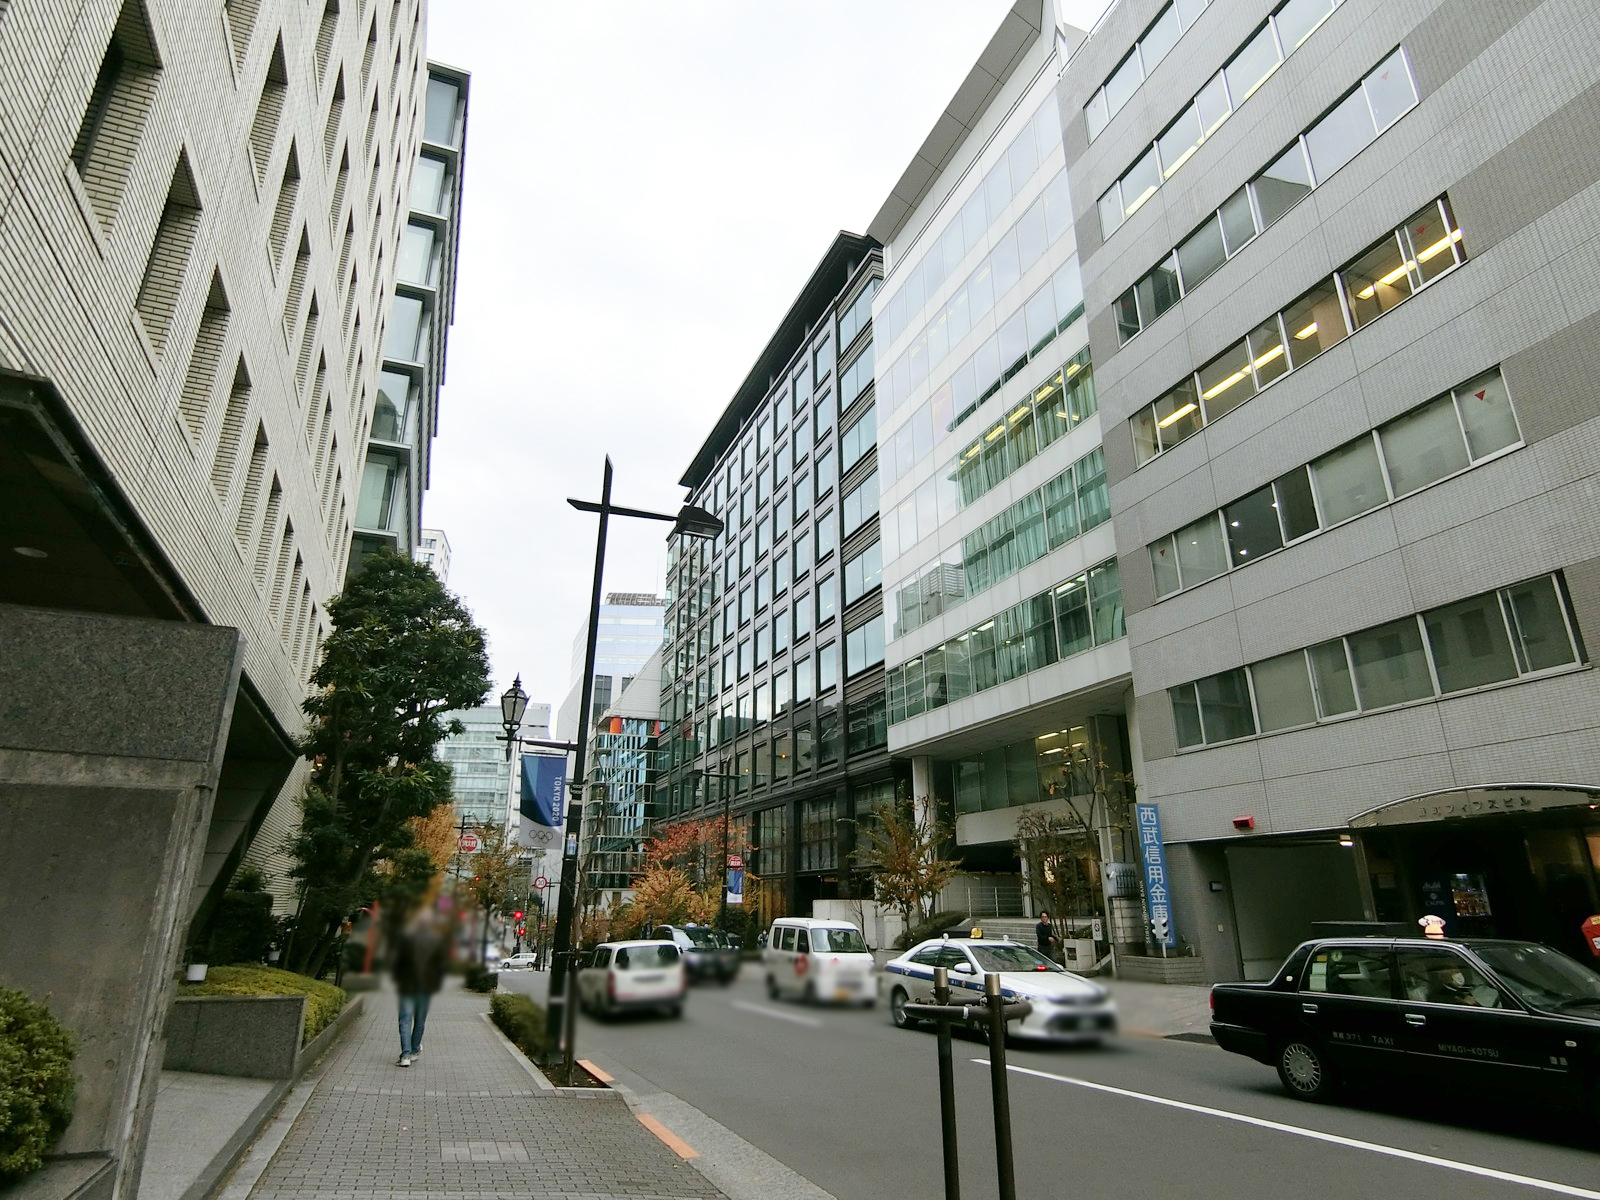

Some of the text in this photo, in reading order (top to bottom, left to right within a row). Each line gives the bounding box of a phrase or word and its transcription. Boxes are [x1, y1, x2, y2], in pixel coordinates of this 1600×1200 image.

[552, 775, 562, 822] TOKYO 2020
[1140, 807, 1168, 922] 西武信用金庫
[1371, 1035, 1394, 1046] TAXI
